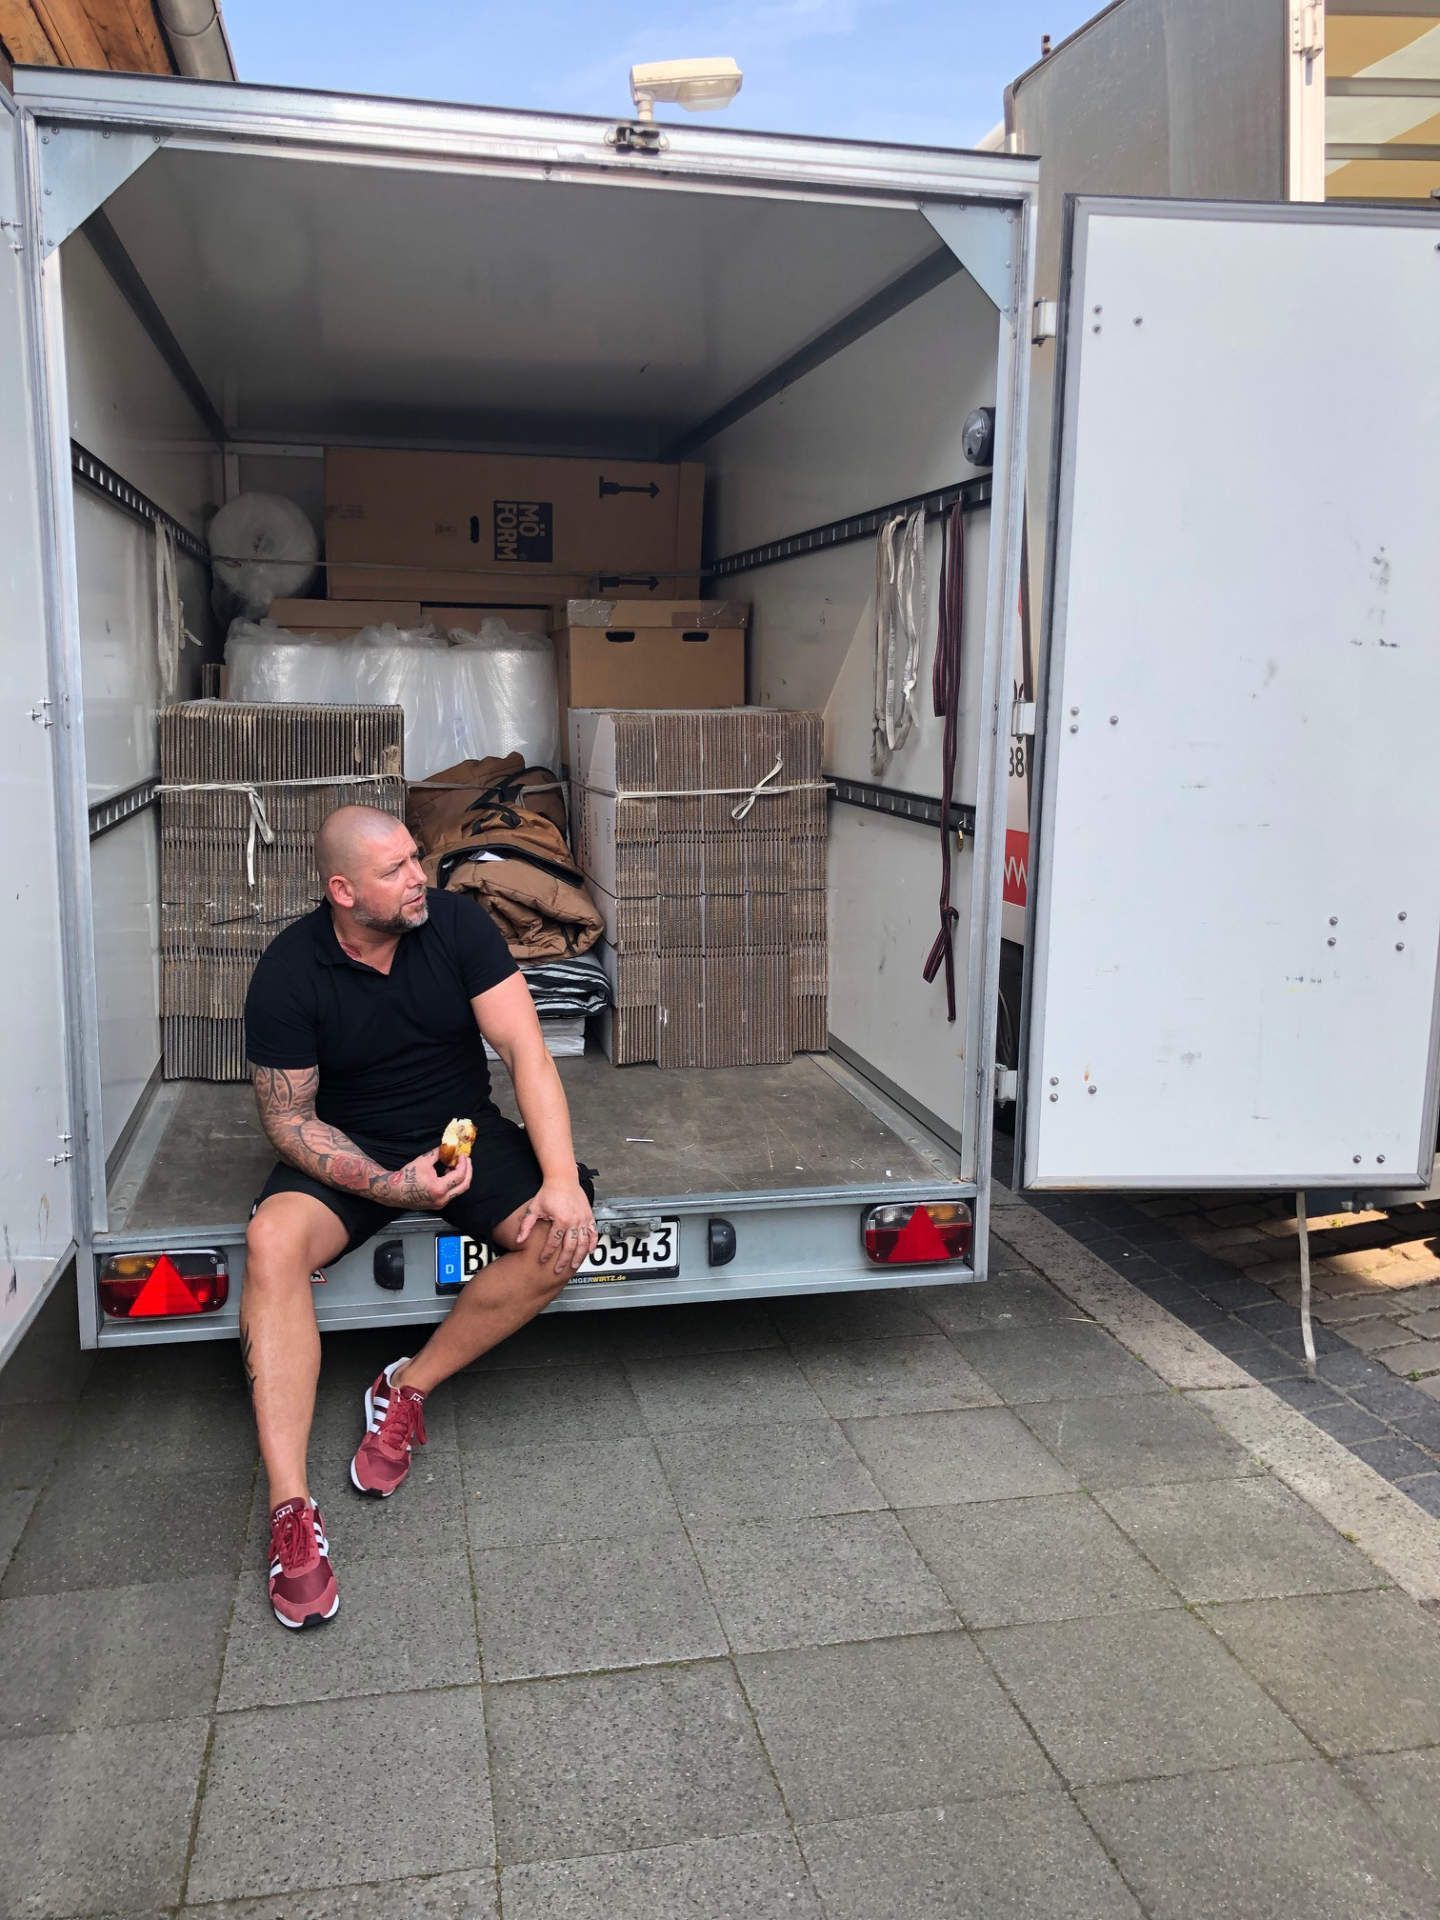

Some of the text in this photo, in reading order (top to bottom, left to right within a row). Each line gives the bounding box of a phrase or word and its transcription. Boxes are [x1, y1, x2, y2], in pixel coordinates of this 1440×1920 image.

[496, 503, 518, 560] FORM
[519, 504, 545, 537] MÖ
[589, 1228, 671, 1266] 6543
[445, 1264, 454, 1274] D
